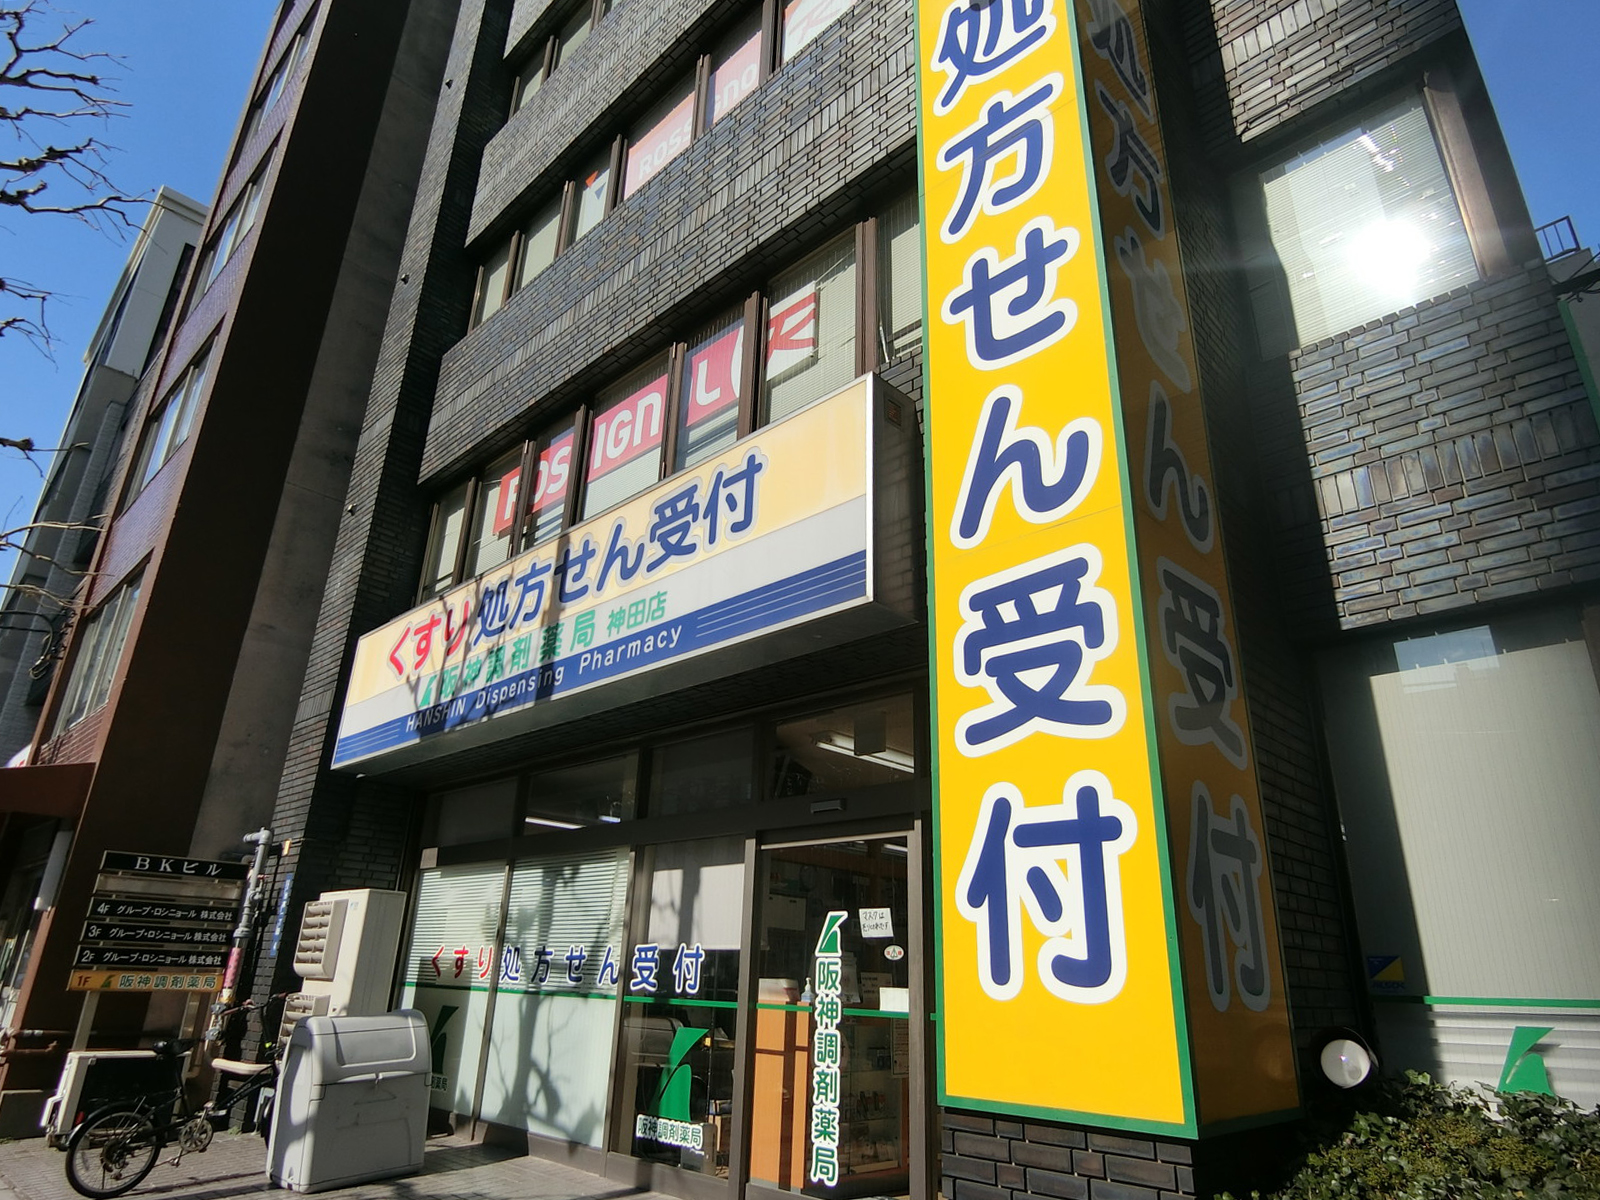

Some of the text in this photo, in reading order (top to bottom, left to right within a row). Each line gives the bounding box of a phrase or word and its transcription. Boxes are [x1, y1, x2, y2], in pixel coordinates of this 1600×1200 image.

[440, 590, 668, 699] 阪神調剤薬局 神田店
[405, 625, 683, 733] HANSHIN Dispensing Pharmacy
[97, 902, 110, 914] 4F
[88, 925, 102, 937] 3F
[81, 950, 95, 963] 2F
[77, 974, 216, 989] 1F 阪神調剤薬局
[811, 958, 841, 1185] 阪神調剤薬局
[636, 1115, 703, 1149] 阪神調剤薬局
